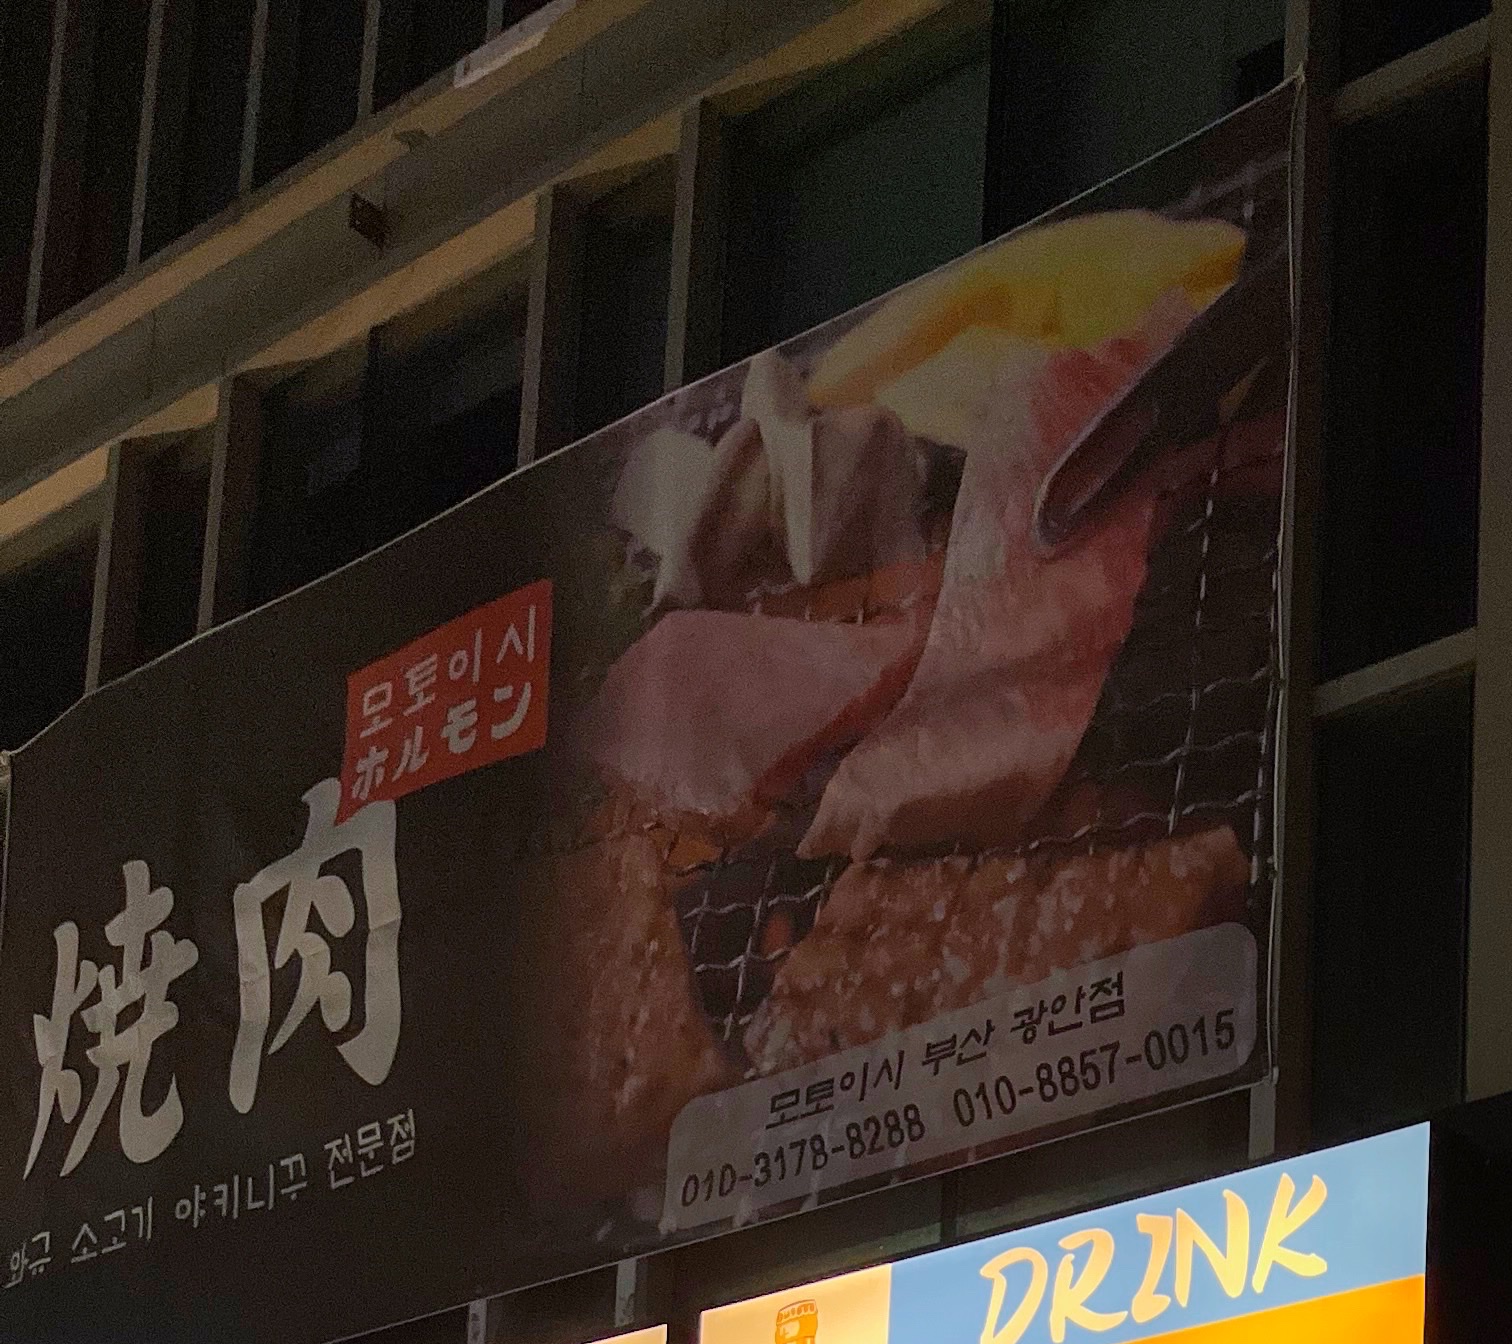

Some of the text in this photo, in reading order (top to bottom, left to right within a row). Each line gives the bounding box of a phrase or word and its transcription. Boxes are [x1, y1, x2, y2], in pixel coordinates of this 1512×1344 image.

[350, 681, 532, 801] ホルモン
[358, 604, 538, 738] 모토이시
[23, 776, 401, 1181] 焼肉
[766, 971, 1126, 1131] 모토이시 부산 광안점
[681, 1008, 1236, 1208] 010-3178-8288 010-8857-0015
[3, 1108, 417, 1289] 와규 소고기 야키니꾸 전문점
